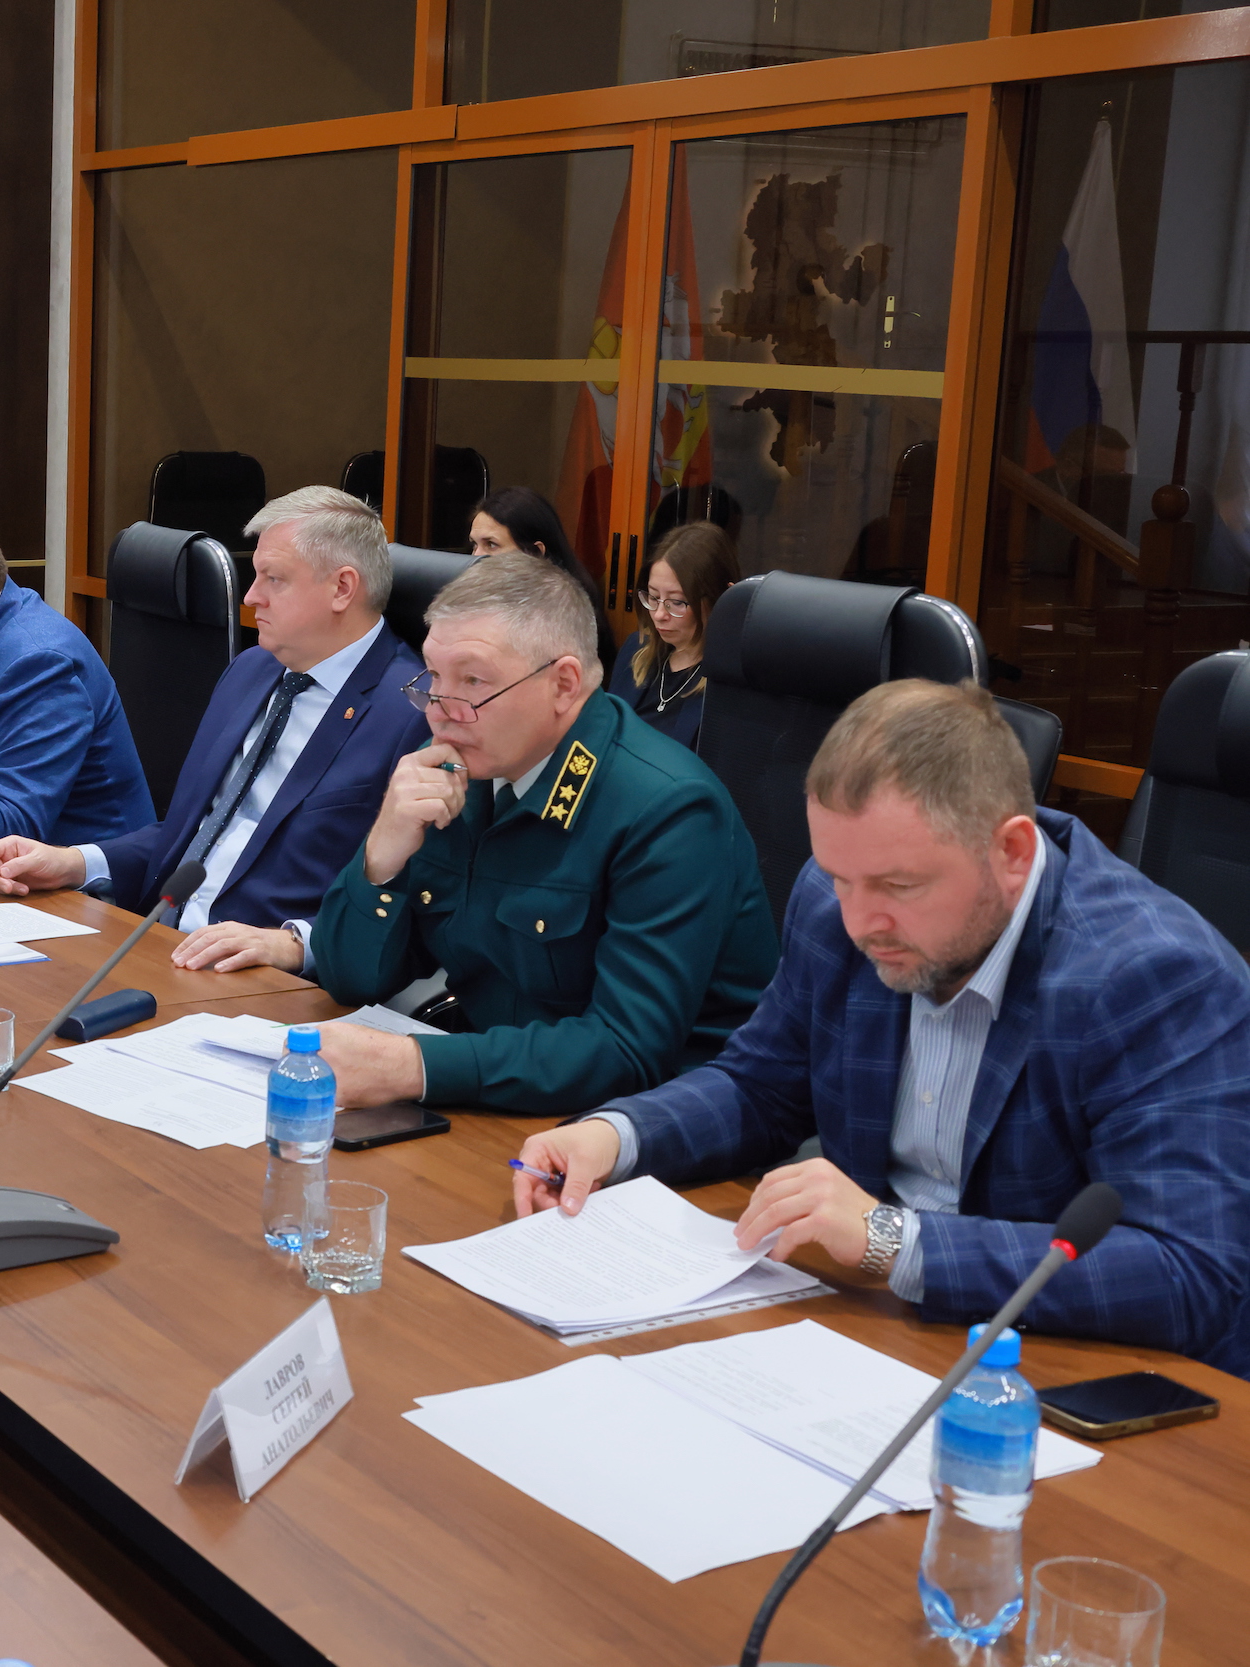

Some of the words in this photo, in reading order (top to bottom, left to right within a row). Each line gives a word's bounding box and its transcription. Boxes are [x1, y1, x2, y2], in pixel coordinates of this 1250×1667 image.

[263, 1353, 306, 1401] ЛАВРОВ
[271, 1375, 313, 1425] СЕРГЕЙ
[262, 1388, 335, 1470] АНАТОЛЬЕВИЧ
